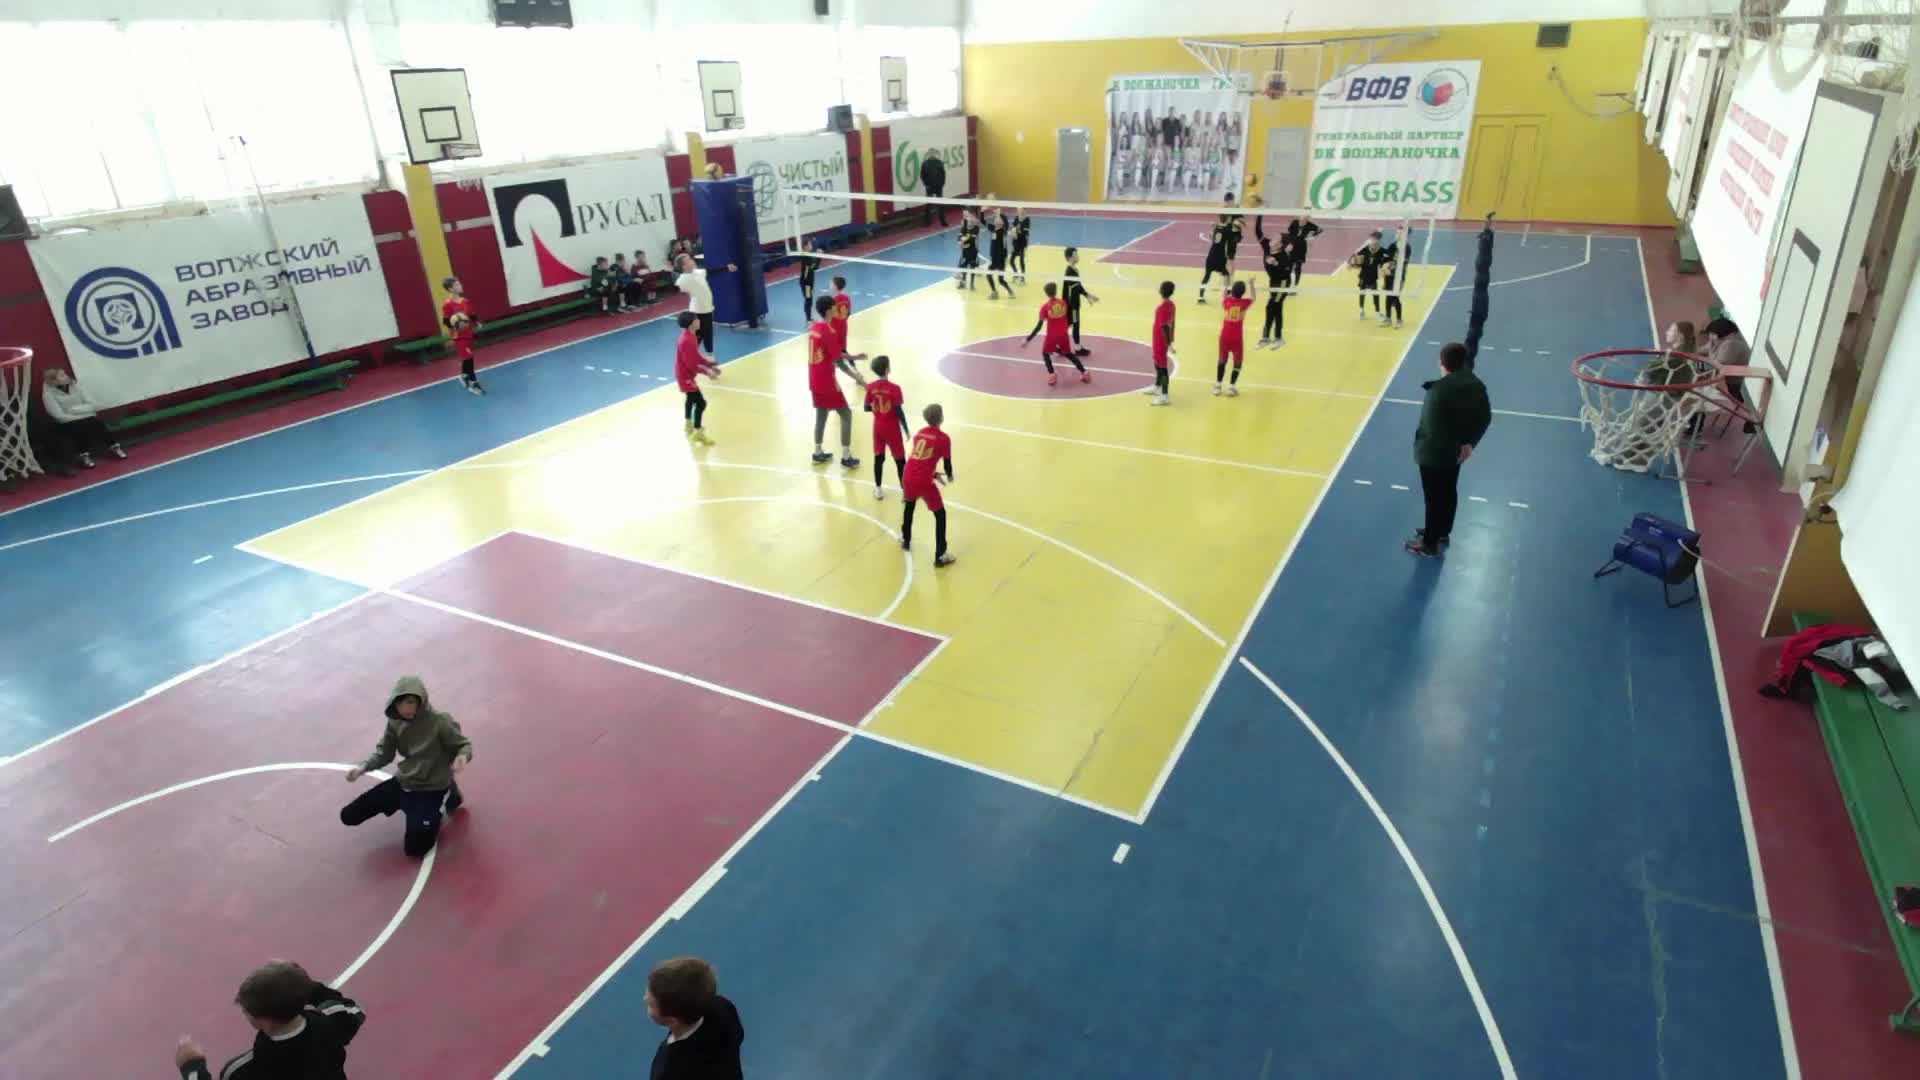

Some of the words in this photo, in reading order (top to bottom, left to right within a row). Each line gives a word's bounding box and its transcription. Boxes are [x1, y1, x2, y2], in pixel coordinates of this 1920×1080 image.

[1346, 76, 1411, 101] ВФВ
[778, 150, 844, 183] ЧИСТЫЙ
[1361, 181, 1455, 204] GRASS
[575, 193, 667, 234] РУСАЛ
[174, 237, 341, 283] ВОЛЖСКИЙ
[190, 297, 290, 330] ЗАВОД
